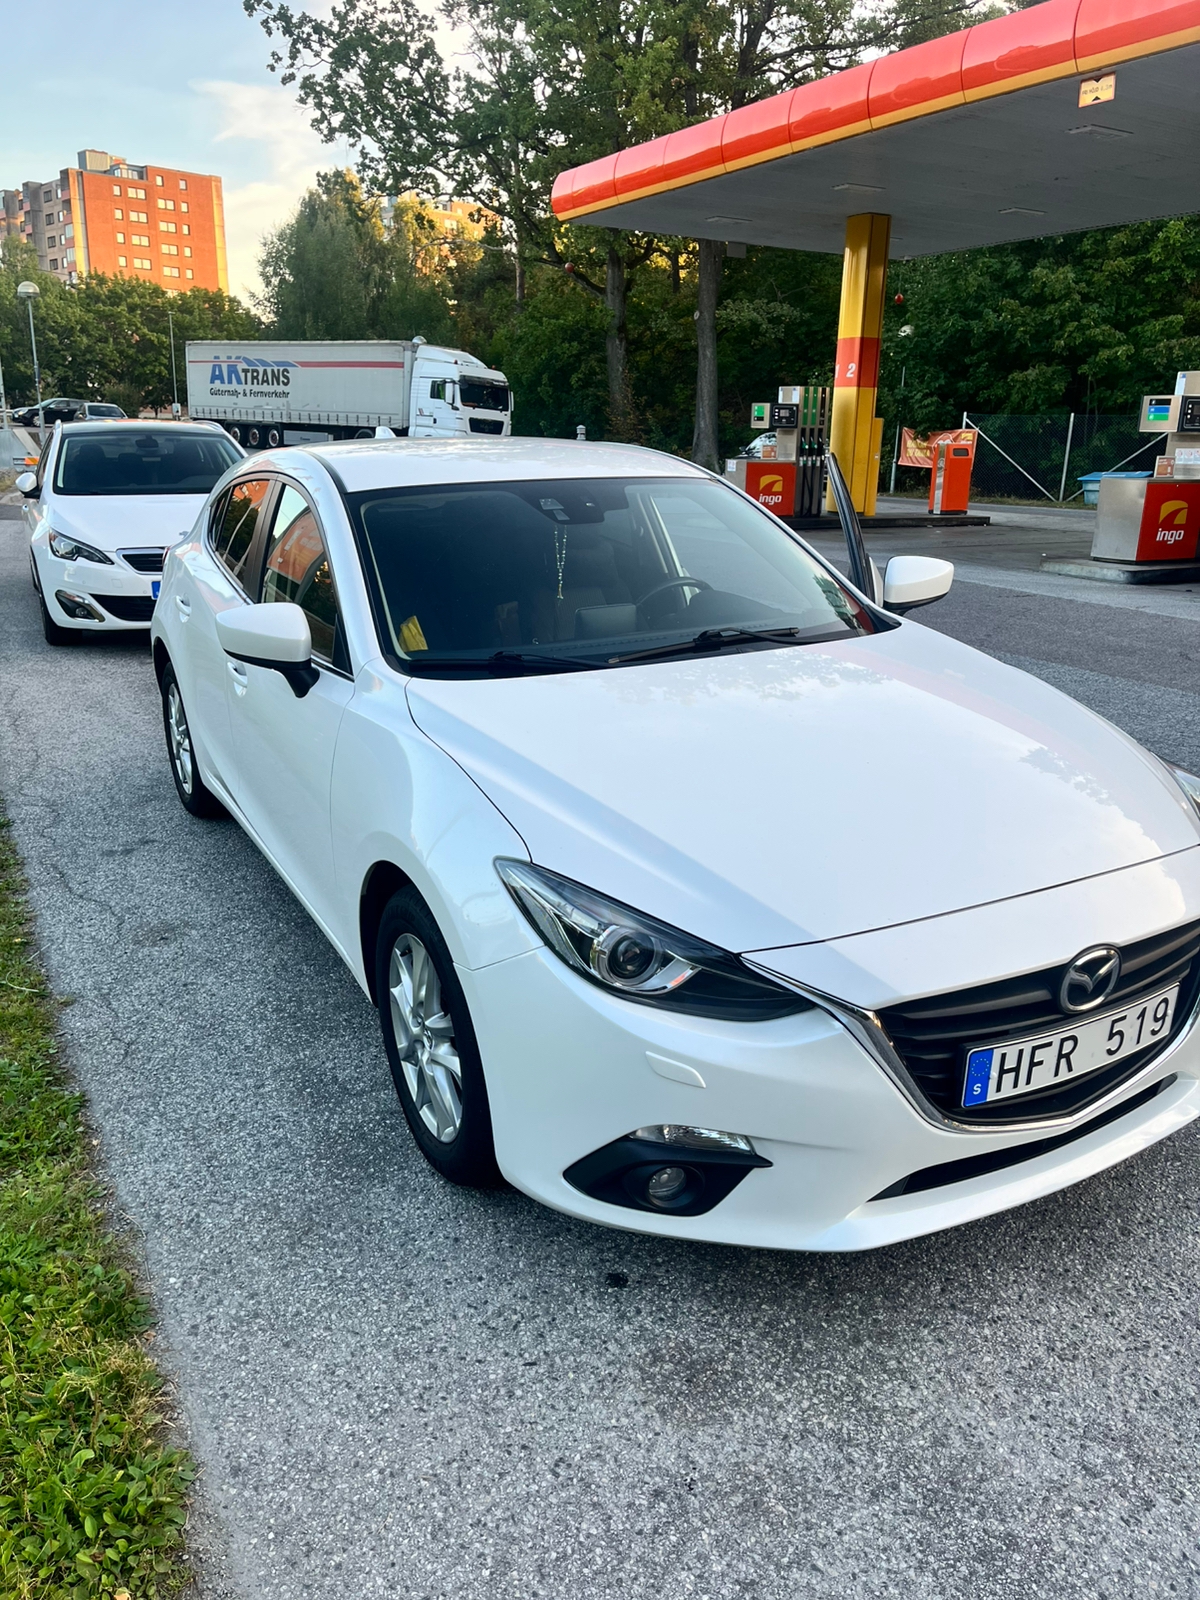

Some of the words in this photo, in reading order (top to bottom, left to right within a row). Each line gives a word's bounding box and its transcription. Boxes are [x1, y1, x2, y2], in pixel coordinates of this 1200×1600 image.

[846, 362, 857, 378] 2
[242, 388, 248, 397] &
[249, 389, 290, 398] Fernverkehr
[759, 493, 782, 506] ingo
[1156, 528, 1184, 544] ingo
[995, 1035, 1079, 1093] HFR
[1106, 997, 1169, 1055] 519
[972, 1083, 982, 1096] S
